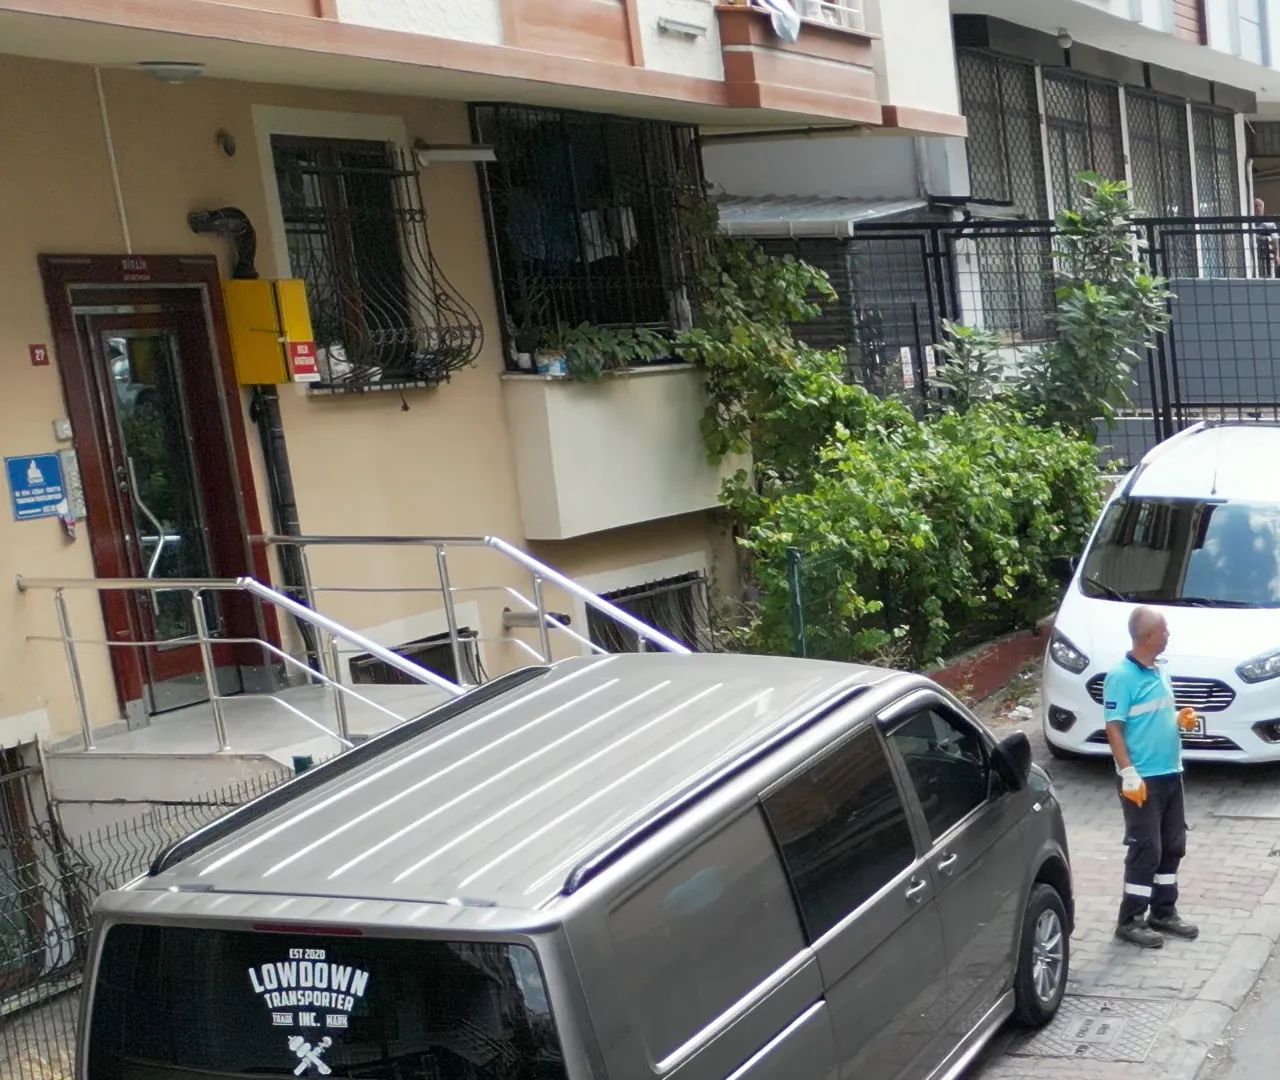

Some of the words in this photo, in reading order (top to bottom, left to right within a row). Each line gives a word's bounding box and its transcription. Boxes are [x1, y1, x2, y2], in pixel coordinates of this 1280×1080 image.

[289, 949, 303, 959] EST
[304, 949, 326, 960] 2020
[248, 961, 369, 997] LOWDOWN
[264, 990, 354, 1012] TRANSPORTER
[299, 1012, 321, 1027] INC.
[327, 1015, 348, 1027] MARK
